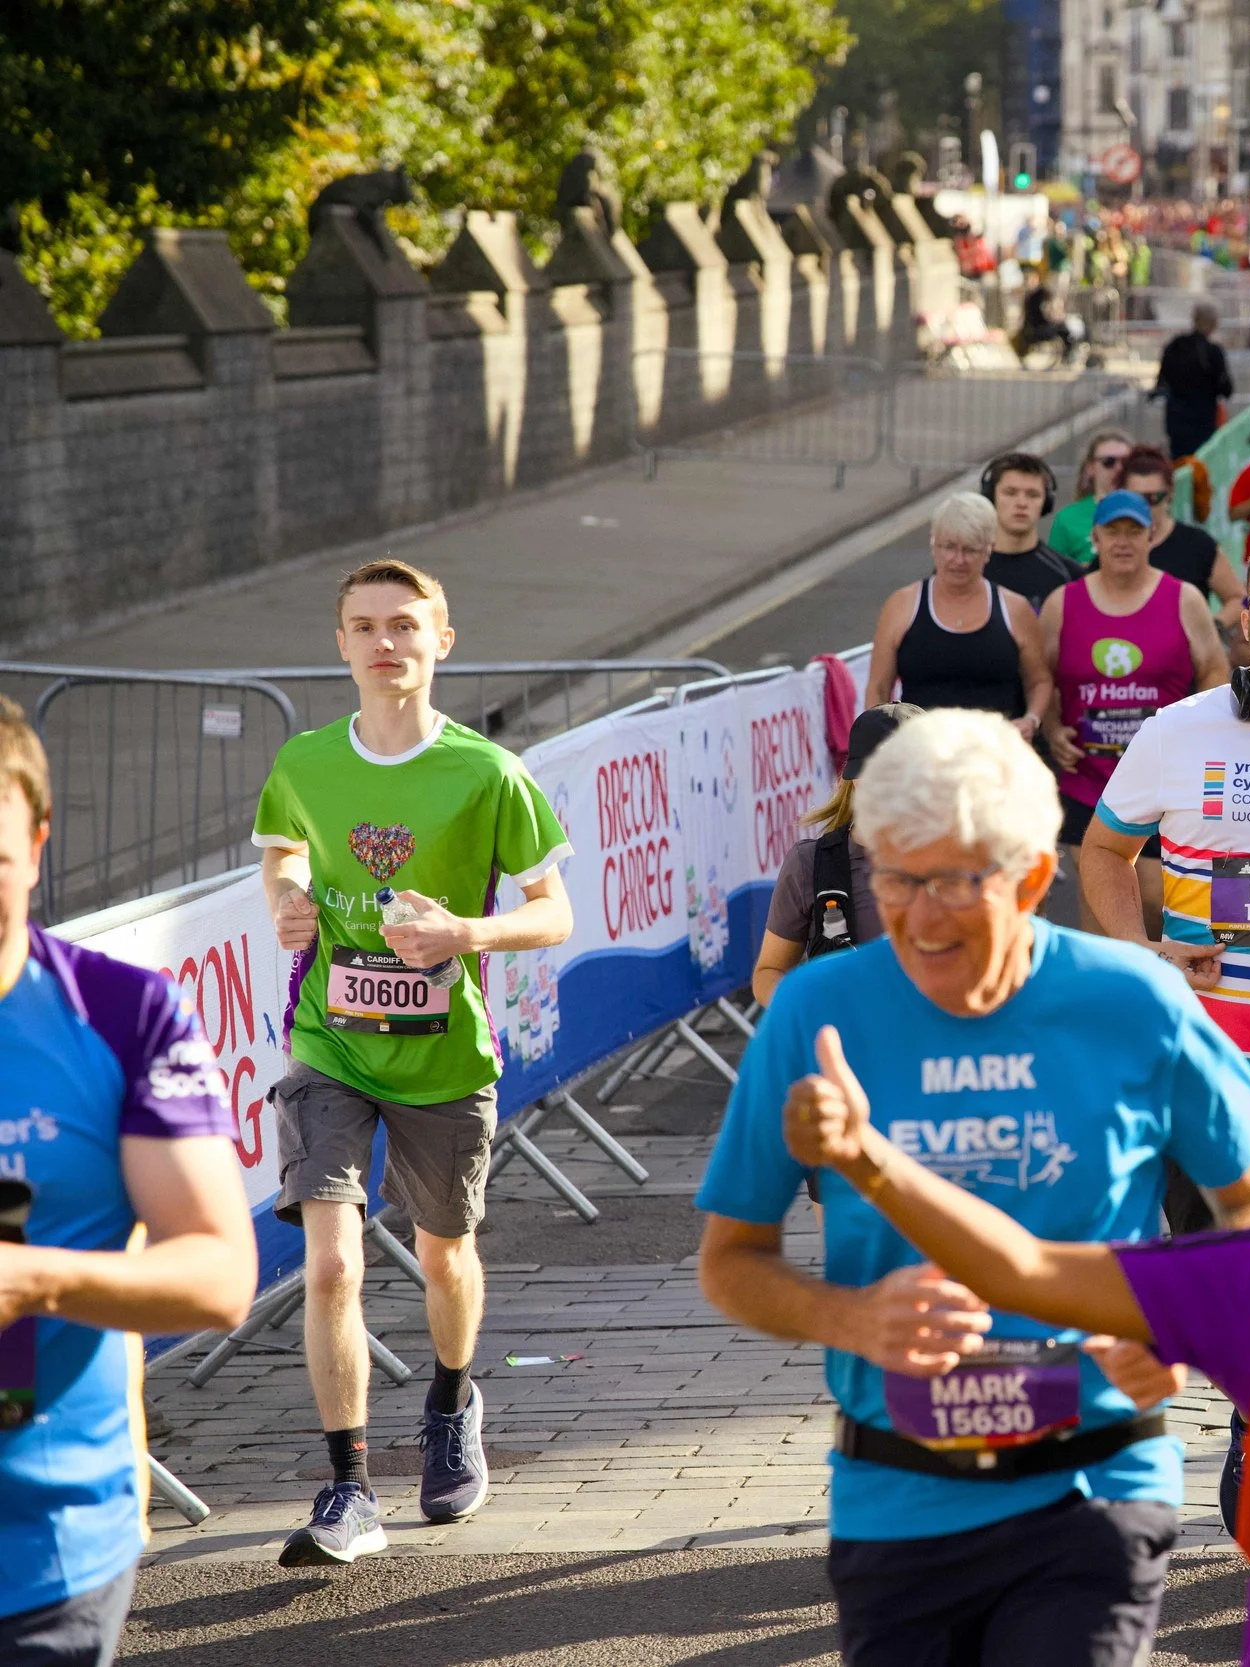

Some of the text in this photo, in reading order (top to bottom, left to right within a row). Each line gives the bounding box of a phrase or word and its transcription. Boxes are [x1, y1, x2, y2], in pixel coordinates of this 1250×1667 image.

[1100, 683, 1159, 701] Hafan
[751, 706, 813, 794] BRECON
[597, 749, 670, 851] BRECON
[325, 887, 355, 917] City
[603, 836, 674, 941] CARREG
[345, 921, 376, 931] Caring
[366, 955, 400, 964] CARDIFF
[344, 975, 428, 1008] 30600
[921, 1053, 1038, 1094] MARK
[889, 1115, 1021, 1152] EVRC
[930, 1373, 1030, 1405] MARK
[931, 1404, 1036, 1436] 15630
